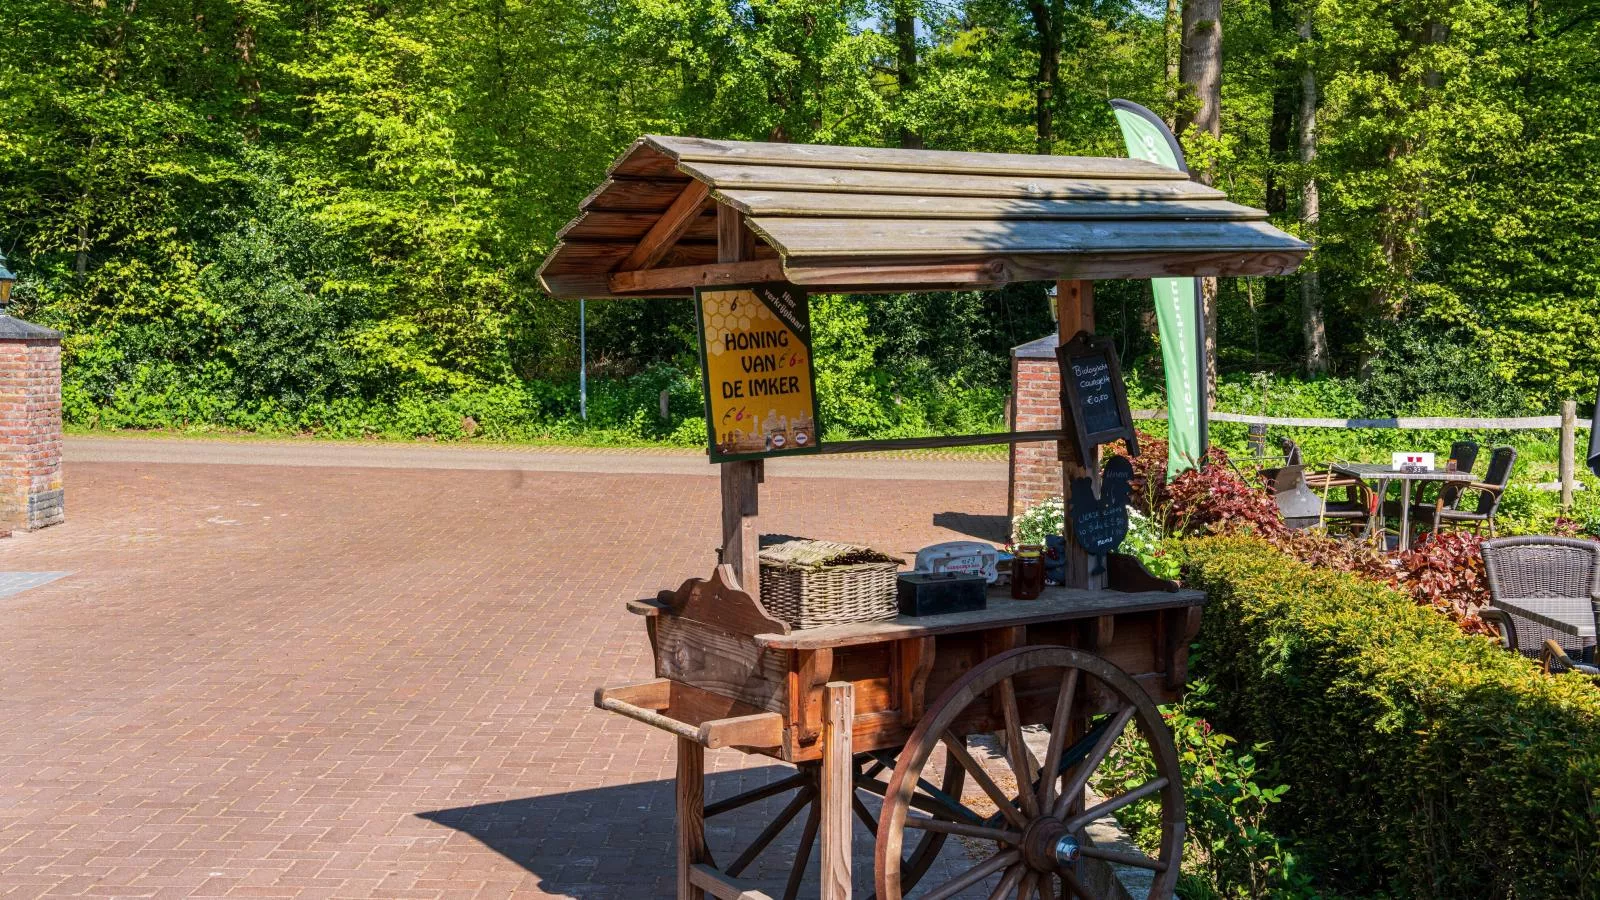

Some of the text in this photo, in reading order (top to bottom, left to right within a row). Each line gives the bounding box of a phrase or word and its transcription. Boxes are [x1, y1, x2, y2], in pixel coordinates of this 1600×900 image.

[782, 291, 796, 308] Hier
[764, 289, 805, 332] verkrijgbaar!
[725, 330, 789, 351] HONING
[741, 354, 776, 373] VAN
[722, 375, 800, 399] DE IMKER
